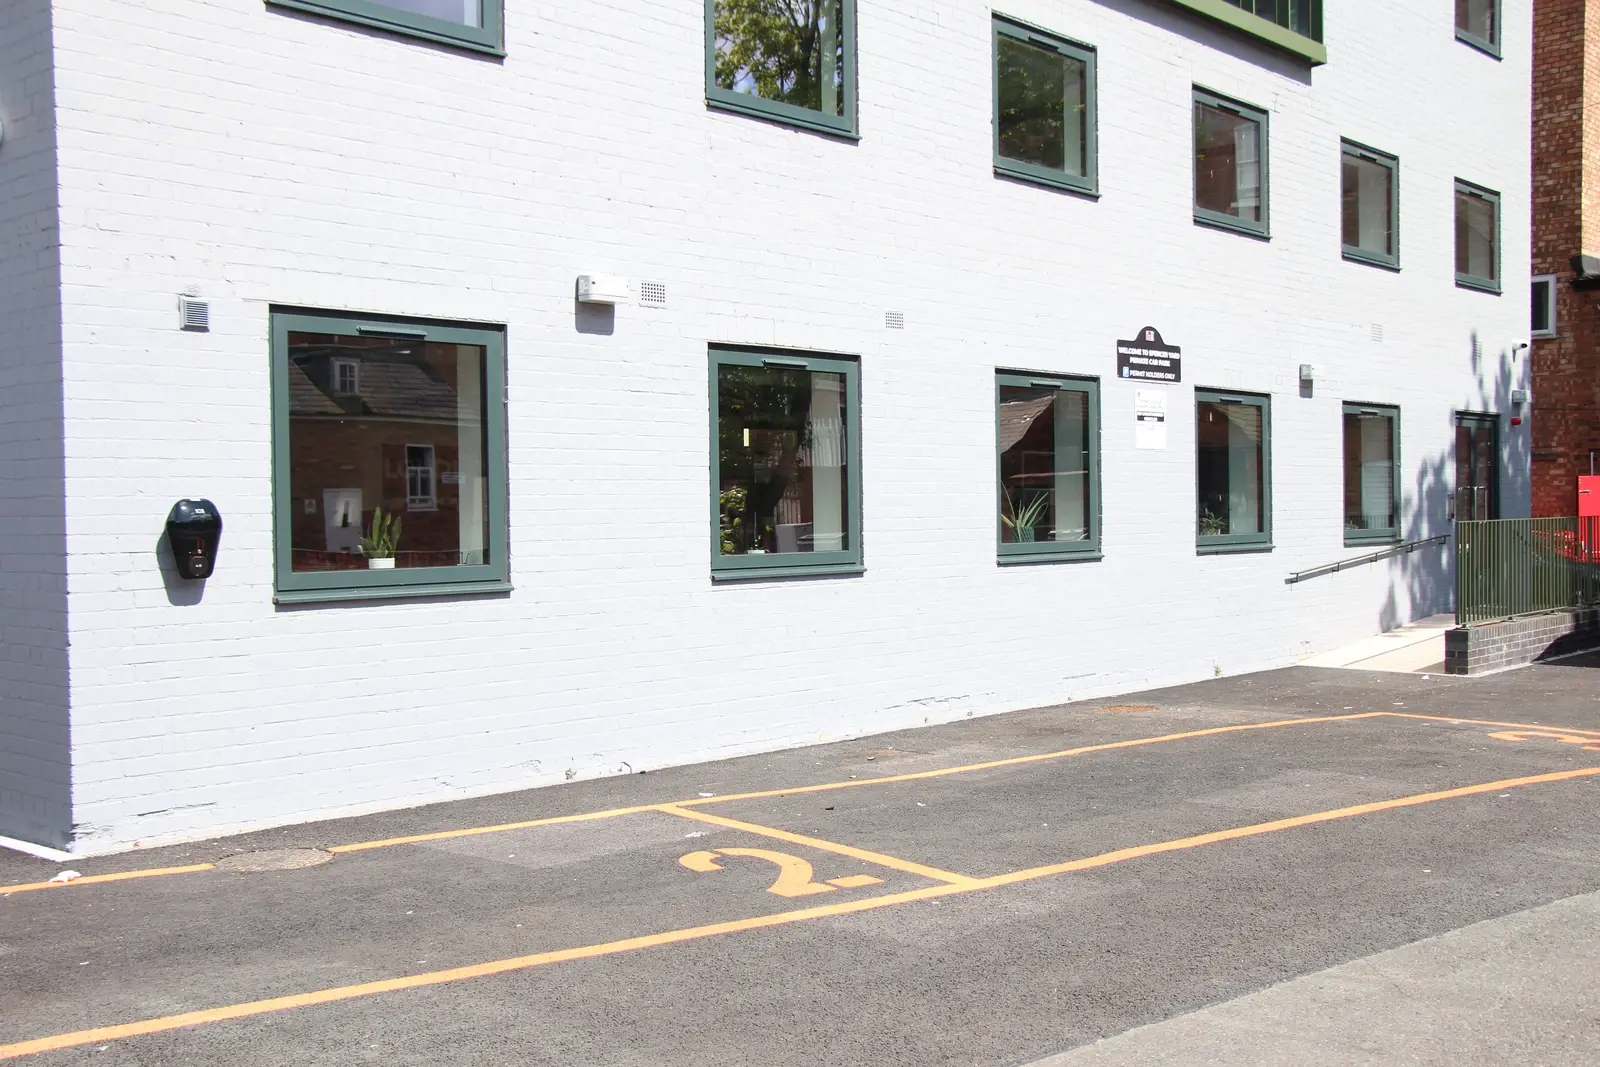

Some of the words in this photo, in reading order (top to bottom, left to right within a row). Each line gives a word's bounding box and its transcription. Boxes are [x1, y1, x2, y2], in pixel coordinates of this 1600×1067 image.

[1118, 346, 1141, 355] WELCOME
[1148, 350, 1168, 358] SPENCER
[1130, 356, 1148, 364] PRIVATE
[678, 847, 885, 898] 2
